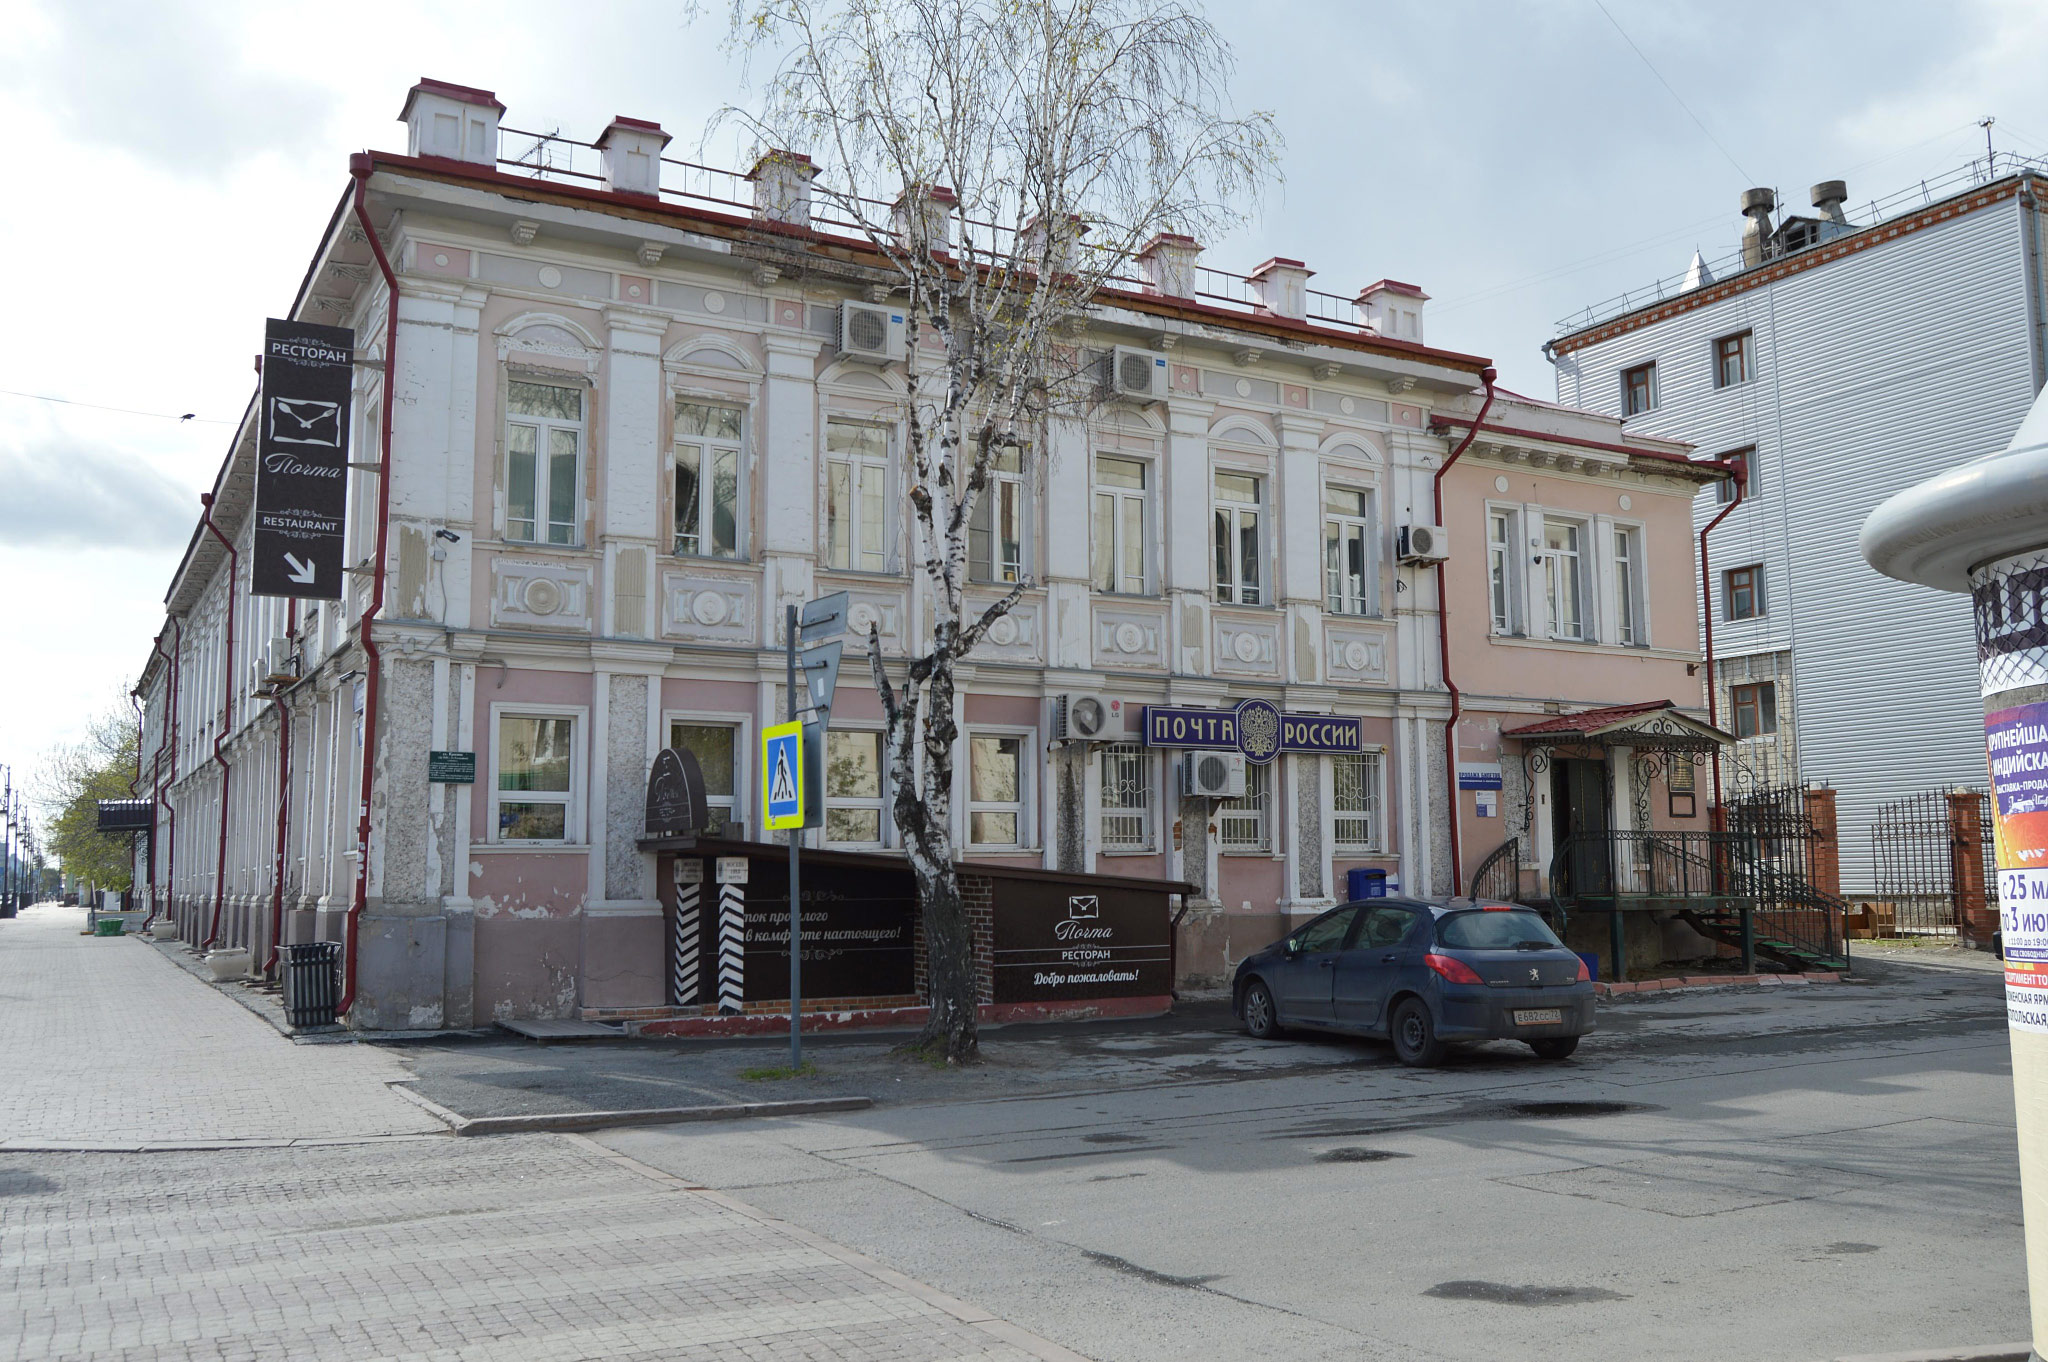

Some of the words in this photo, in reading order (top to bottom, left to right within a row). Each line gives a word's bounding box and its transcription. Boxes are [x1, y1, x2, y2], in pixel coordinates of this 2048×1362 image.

[272, 342, 346, 363] РЕСТОРАН
[264, 452, 342, 479] Почта
[263, 516, 338, 532] RESTAURANT
[1155, 716, 1235, 742] ПОЧТА
[1284, 723, 1358, 747] РОССИИ
[1996, 779, 2048, 795] ВЫСТАВКА-ПРОДА
[2009, 874, 2027, 900] 25
[2031, 881, 2048, 899] М
[769, 911, 828, 926] пролого
[2011, 906, 2019, 932] 3
[2022, 913, 2048, 933] ИЮ
[745, 928, 753, 942] в
[754, 929, 821, 944] комфте
[823, 926, 901, 942] настоящего!
[1054, 920, 1113, 940] Почта
[2033, 938, 2048, 946] 19:0
[1061, 950, 1111, 960] РЕСТОРАН
[1034, 971, 1065, 987] Добро
[1067, 969, 1139, 983] пожаловать!
